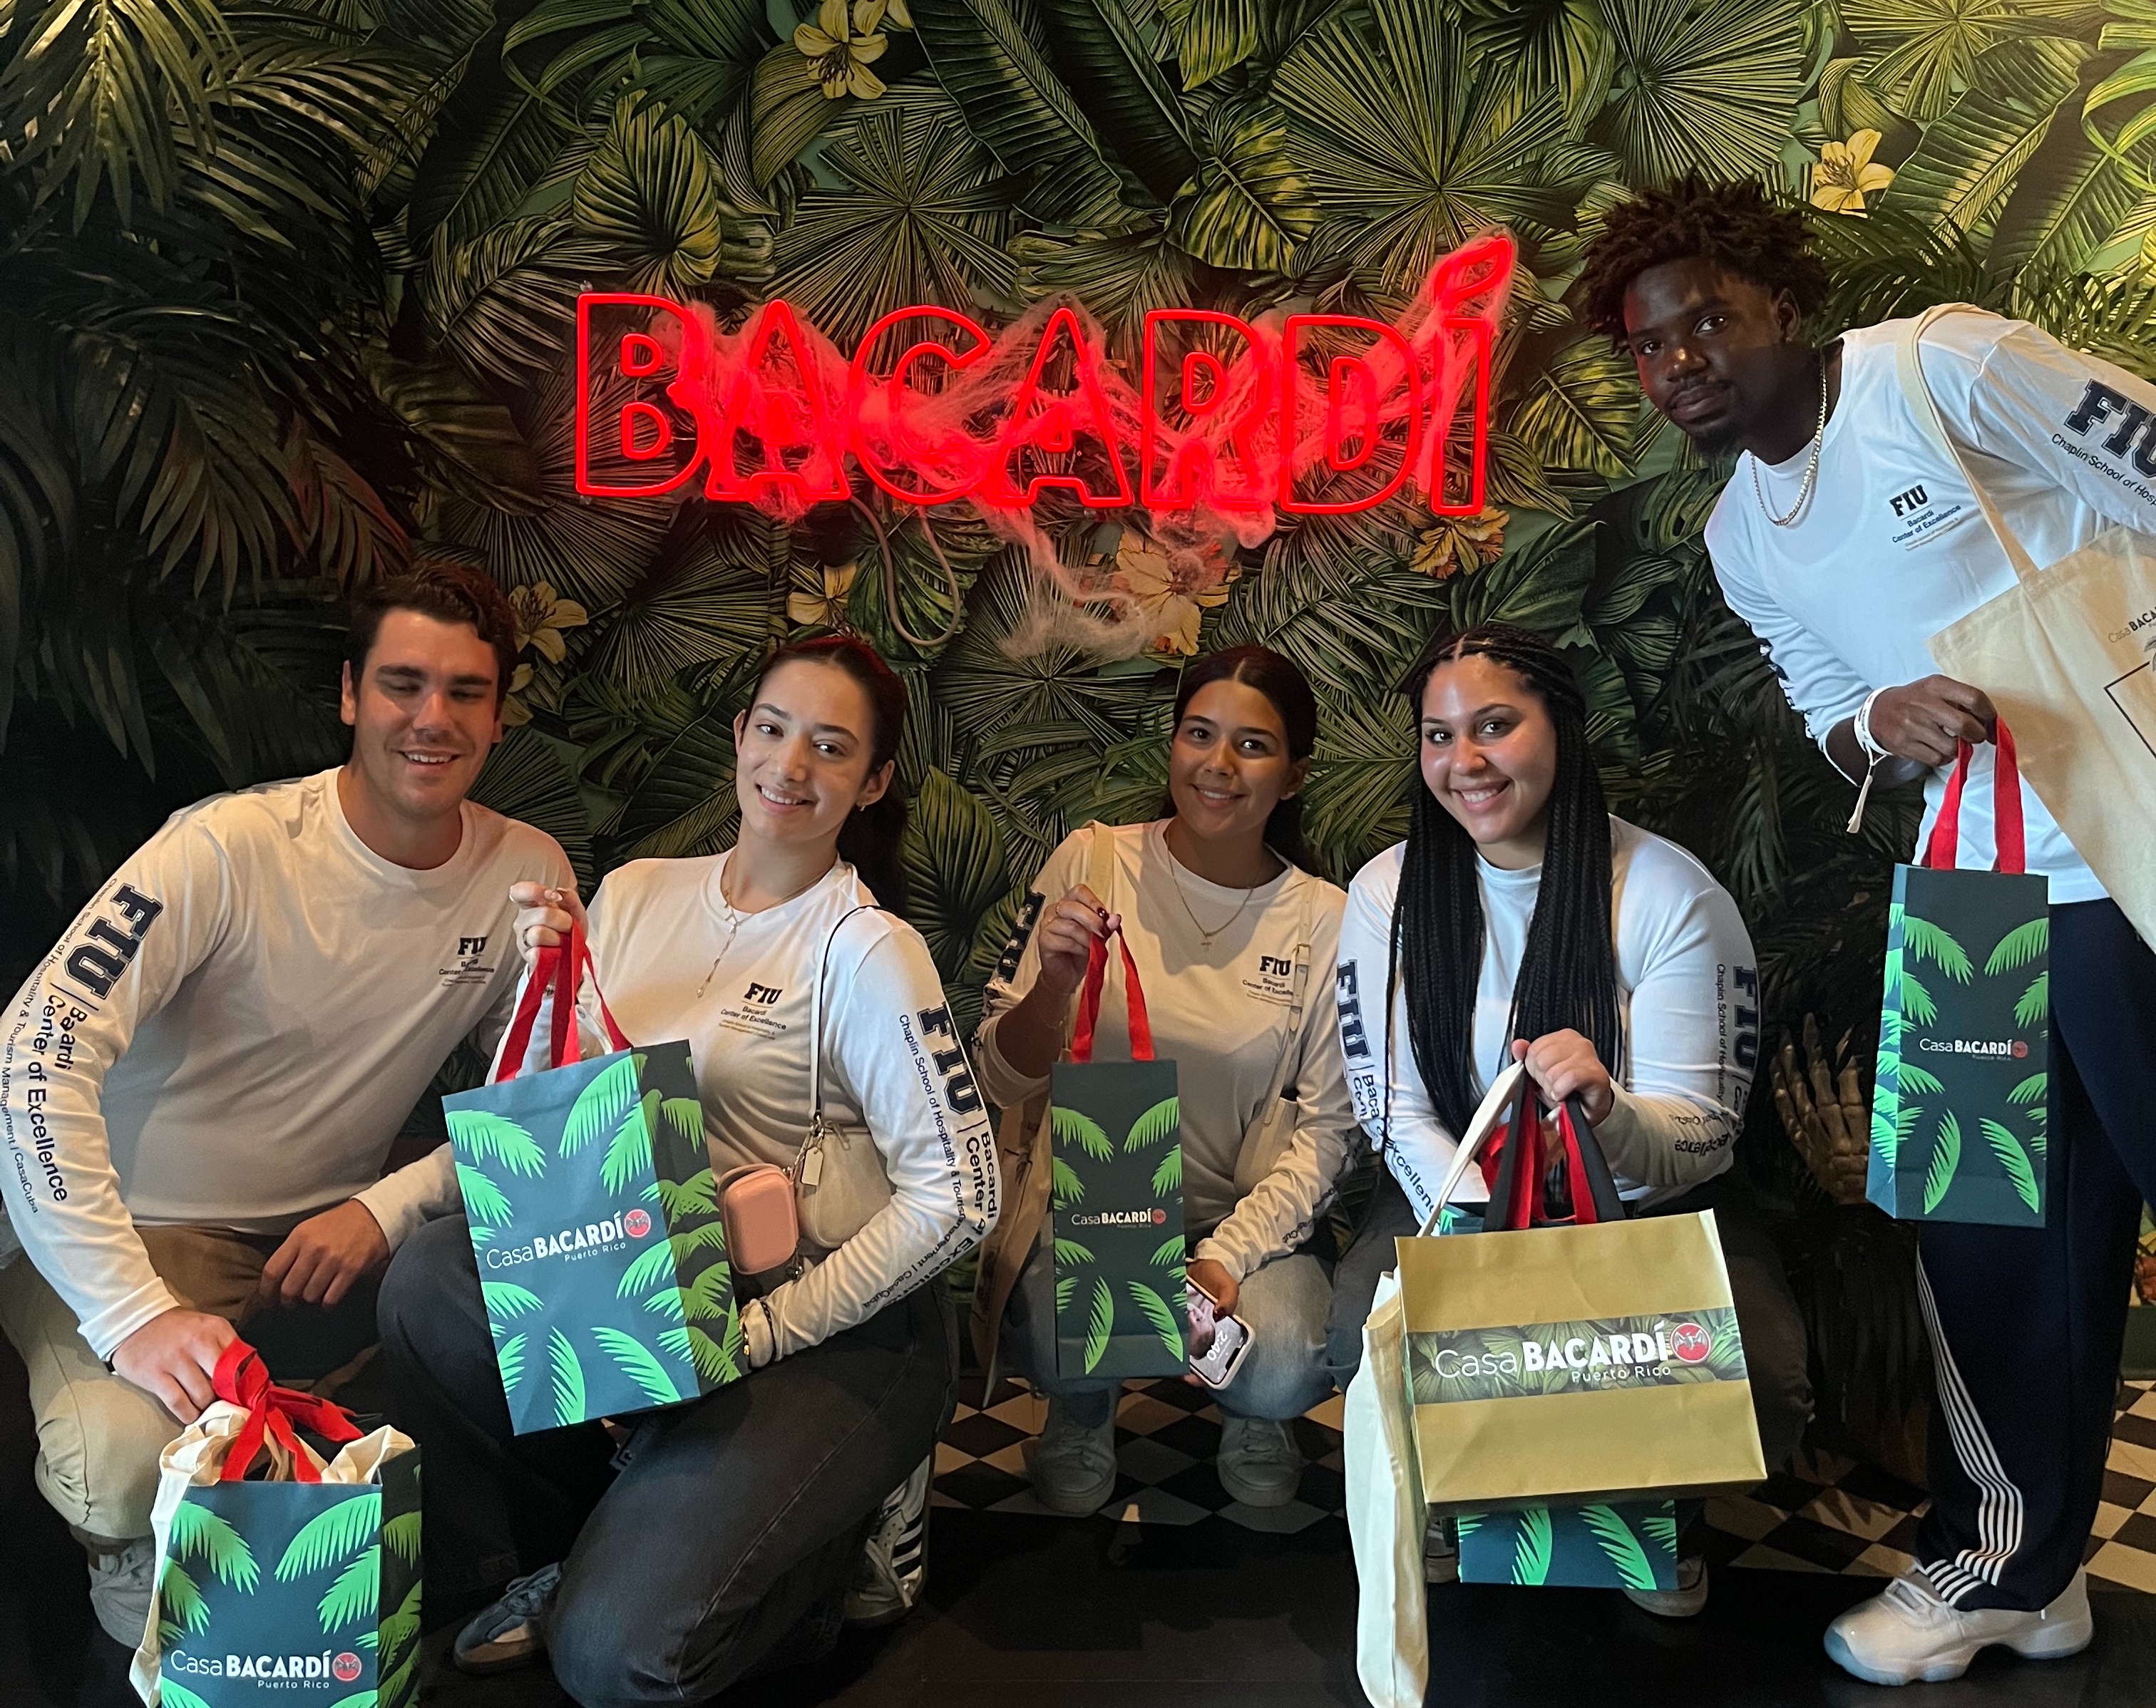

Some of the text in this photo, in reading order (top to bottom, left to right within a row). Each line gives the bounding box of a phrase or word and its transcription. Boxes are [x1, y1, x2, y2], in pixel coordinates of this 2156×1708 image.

[575, 236, 1513, 517] BACARDÍ
[2051, 433, 2089, 461] Chaplin
[2088, 456, 2125, 481] School
[2123, 480, 2137, 489] of
[1889, 484, 1928, 517] FIU
[2108, 627, 2132, 643] Casa
[2128, 605, 2156, 631] BACA
[63, 911, 91, 943] School
[64, 883, 163, 1000] FIU
[1260, 955, 1292, 977] FIU
[1715, 963, 1726, 1001] Chaplin
[744, 982, 783, 1004] FIU
[55, 1006, 88, 1070] Baardi
[899, 1014, 919, 1056] Chaplin
[1716, 1002, 1728, 1036] School
[5, 1022, 27, 1064] Tourism
[917, 1001, 984, 1115] FIU
[1718, 1038, 1728, 1050] of
[1919, 1038, 2012, 1056] Casa BACARDÍ
[915, 1056, 935, 1095] School
[27, 994, 68, 1202] Center of Excellence
[929, 1098, 940, 1109] of
[1362, 1074, 1380, 1120] Baca
[933, 1110, 956, 1168] Hospitality
[966, 1136, 985, 1211] Center
[981, 1131, 997, 1219] Bacardi
[1071, 1208, 1151, 1225] Casa BACARDÍ
[486, 1210, 625, 1269] Casa BACARDÍ
[564, 1242, 626, 1262] Puerto Rico
[917, 1217, 965, 1267] anagement
[1206, 1330, 1228, 1361] 2:40
[1435, 1320, 1668, 1379] Casa BACARDÍ
[1571, 1364, 1672, 1384] Puerto Rico
[170, 1650, 331, 1678] Casa BACARDÍ
[257, 1680, 329, 1689] Puerto Rico
